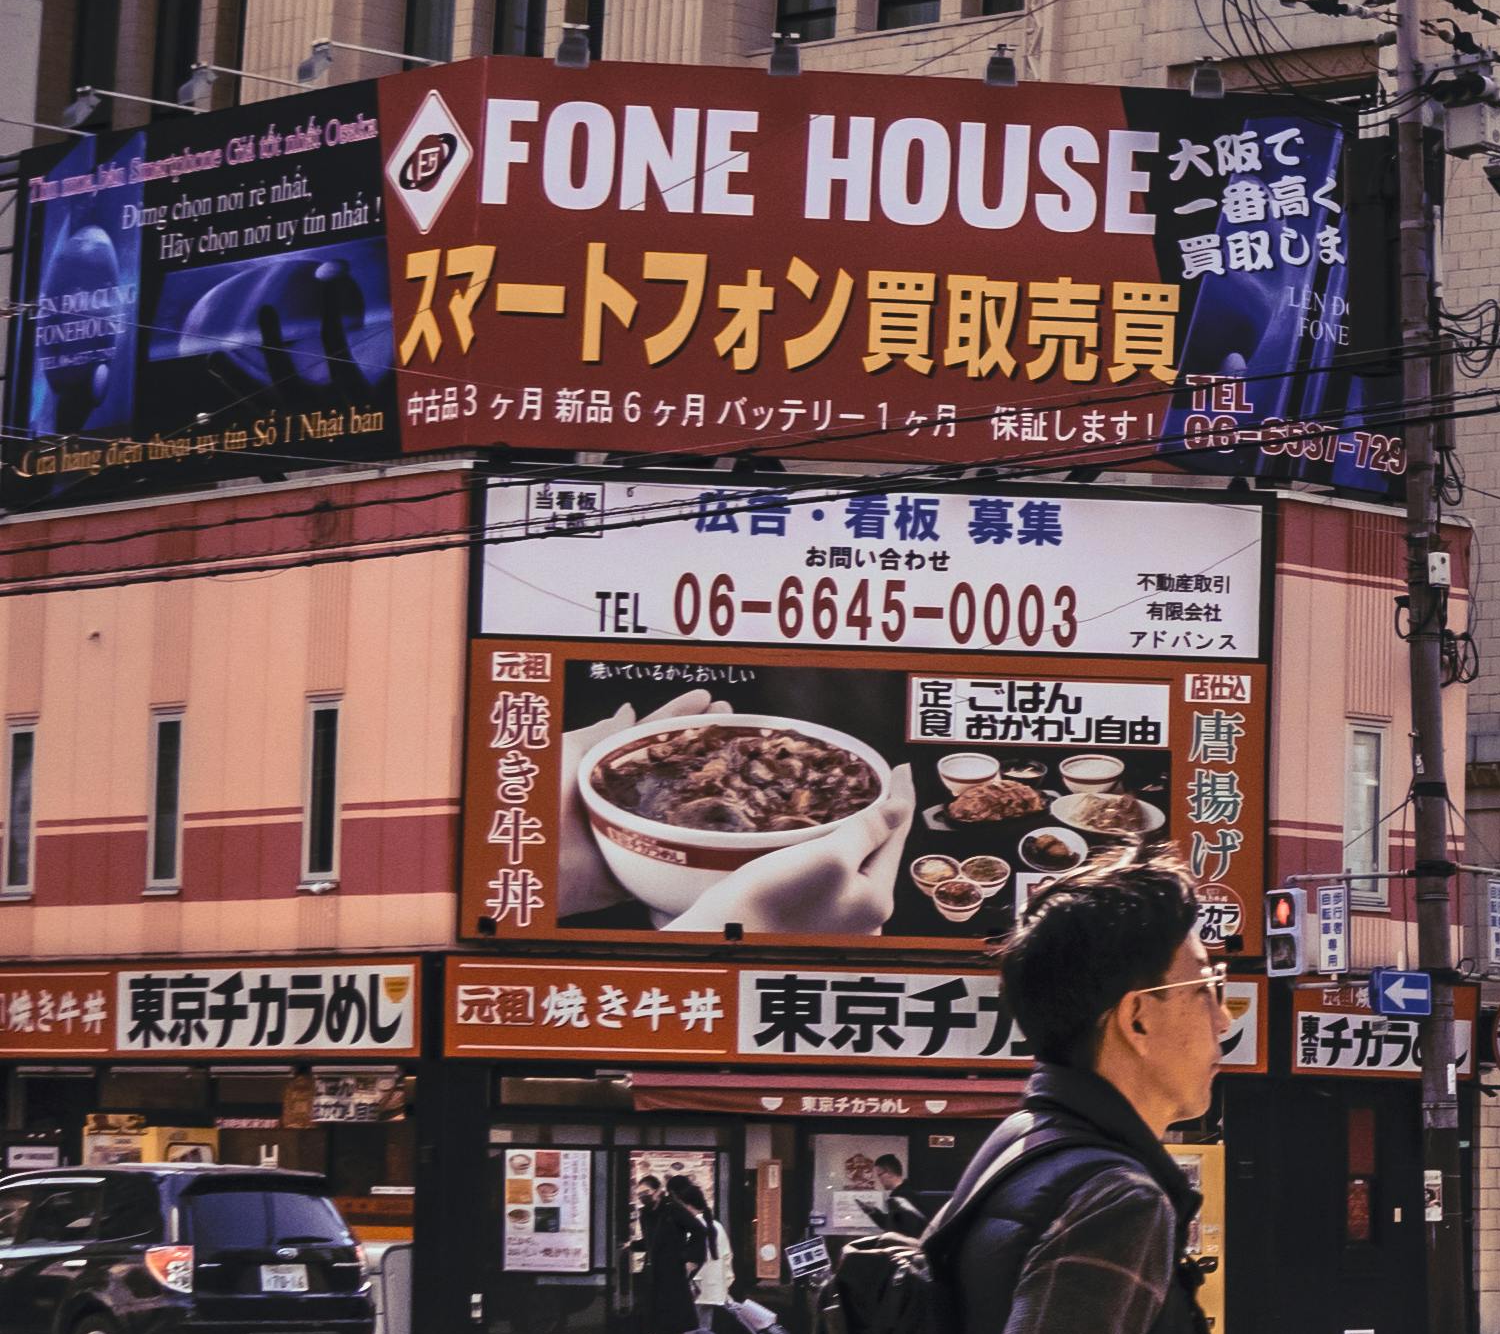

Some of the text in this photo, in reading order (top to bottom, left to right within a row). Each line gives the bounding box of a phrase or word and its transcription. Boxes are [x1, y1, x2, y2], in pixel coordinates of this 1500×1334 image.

[480, 98, 760, 216] FONE
[804, 114, 1160, 236] HOUSE
[1168, 127, 1304, 182] 大阪で
[1173, 174, 1341, 225] 一番高く
[1178, 224, 1346, 280] 買取しま
[400, 242, 1180, 386] スマートフォン買取売買
[1184, 374, 1253, 414] TEL
[968, 499, 1063, 546] 募集
[805, 546, 950, 571] お問い合わせ
[1137, 573, 1230, 595] 不動産取引
[596, 571, 1077, 648] TEL 06-6645-0003
[1146, 602, 1222, 623] 有限会社
[1129, 630, 1236, 651] アドバンス
[920, 680, 953, 738] 定食
[967, 680, 1083, 714] ごはん
[965, 714, 1161, 746] おかわり自由
[487, 691, 551, 927] 焼き牛丼
[1187, 708, 1246, 883] 唐揚げ
[127, 971, 404, 1049] 東京チカラめし
[542, 982, 724, 1033] 焼き牛丼
[801, 1096, 910, 1114] 東京チカラめし
